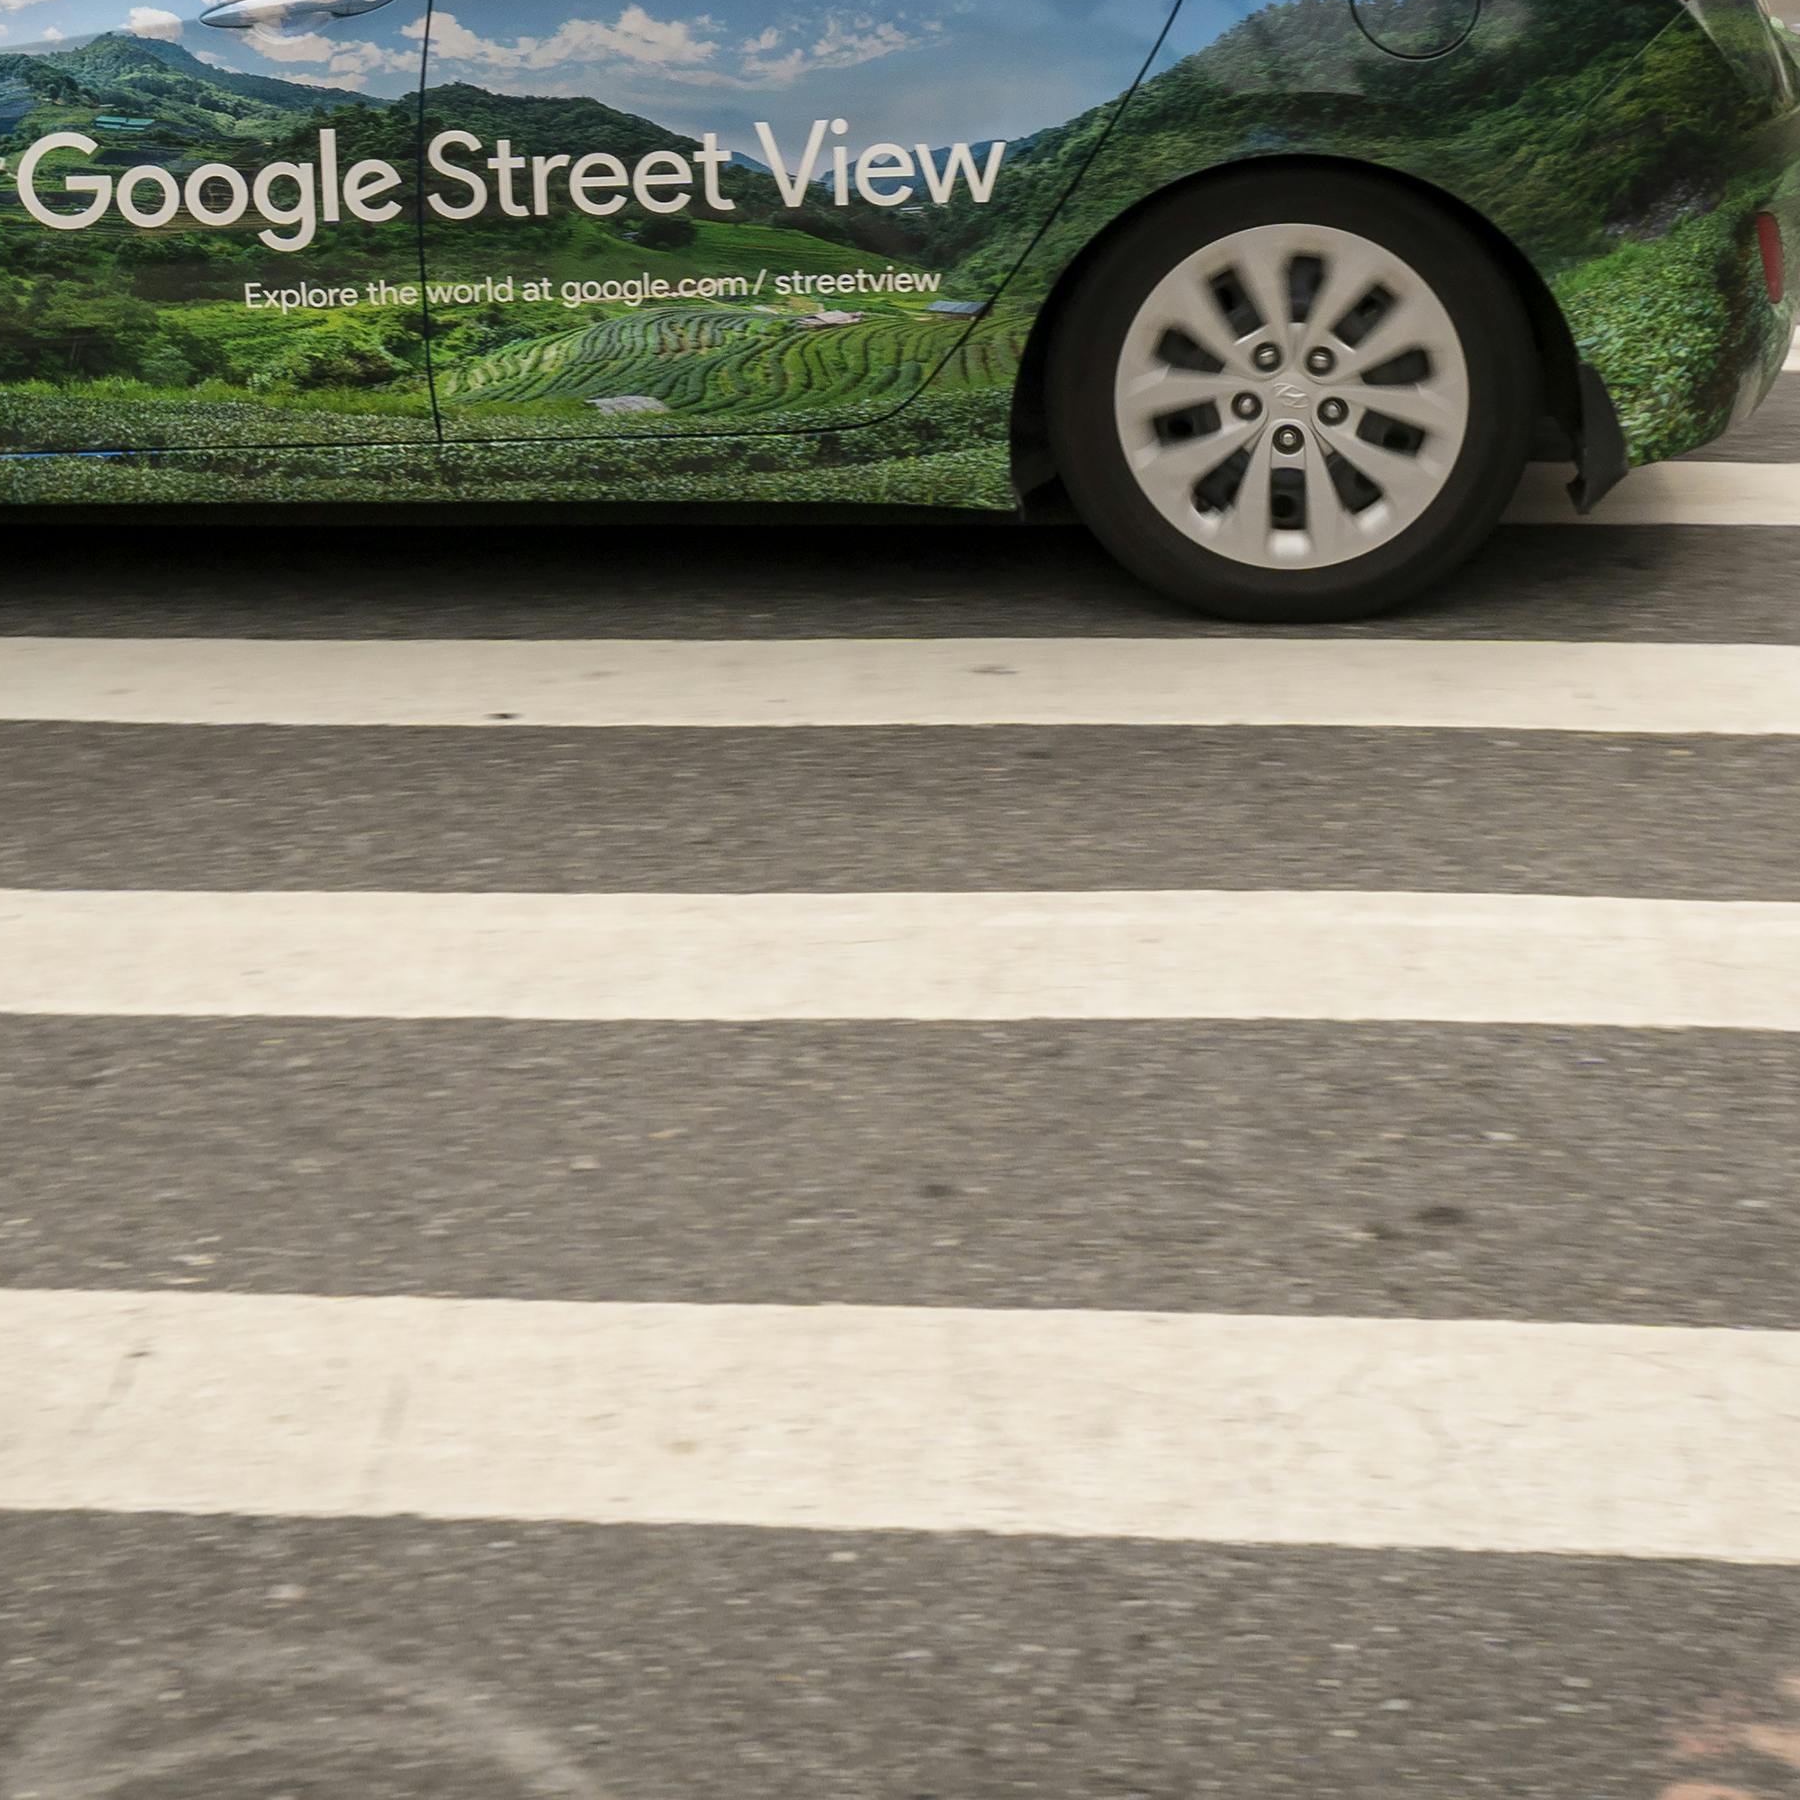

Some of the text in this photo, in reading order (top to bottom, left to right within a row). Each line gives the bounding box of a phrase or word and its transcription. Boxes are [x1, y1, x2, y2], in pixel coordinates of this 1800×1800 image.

[16, 117, 1007, 253] Google Street View
[243, 281, 359, 315] Explore
[366, 279, 419, 306] the
[425, 275, 515, 304] world
[521, 275, 554, 301] at
[774, 265, 942, 295] streetview
